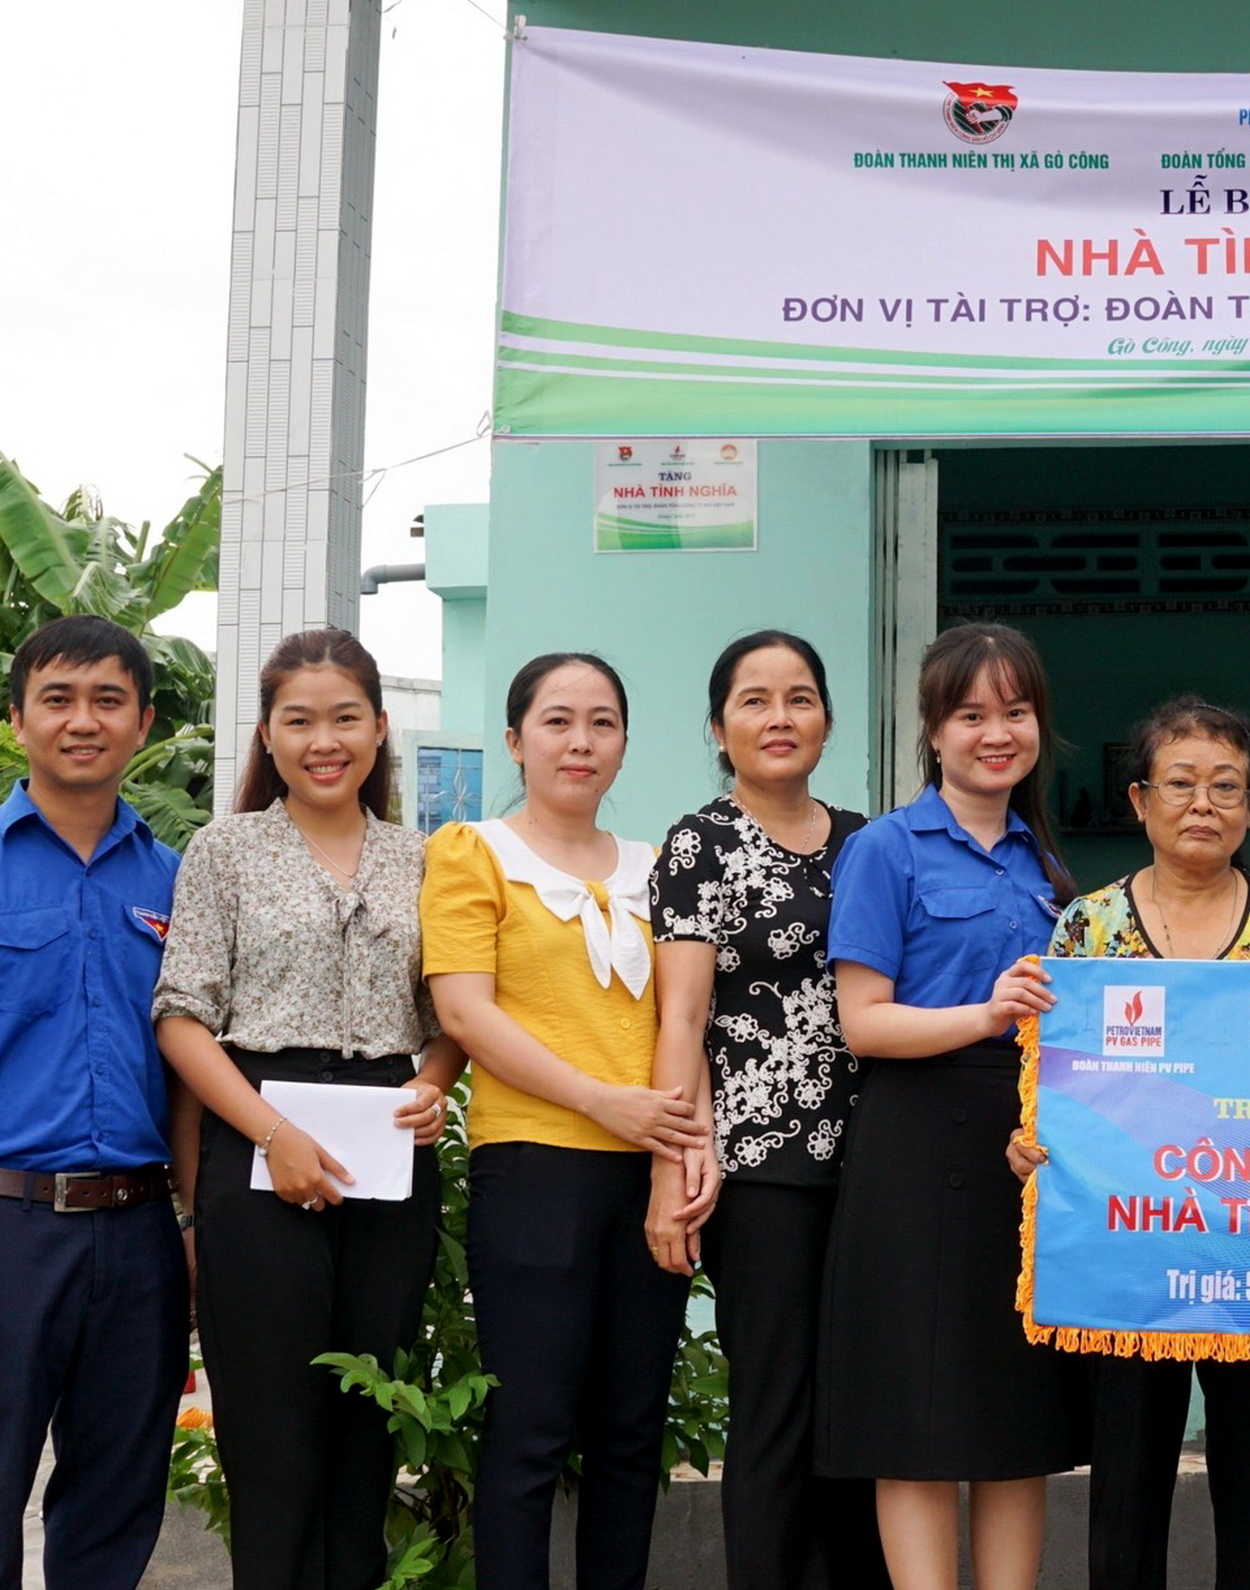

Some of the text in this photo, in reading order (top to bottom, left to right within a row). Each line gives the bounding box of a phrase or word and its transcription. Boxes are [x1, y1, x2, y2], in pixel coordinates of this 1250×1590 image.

[854, 150, 1109, 172] ĐOÀN THANH NIÊN THỊ XÃ GÒ CÔNG
[1161, 151, 1201, 169] ĐOÀN
[1207, 148, 1246, 168] TỔNG
[1160, 175, 1210, 215] LỄ
[1036, 228, 1164, 277] NHÀ
[782, 295, 864, 322] ĐƠN
[879, 298, 913, 328] VỊ
[926, 290, 986, 322] TÀI
[1000, 295, 1090, 328] TRỢ:
[1105, 290, 1213, 321] ĐOÀN
[613, 483, 737, 498] NHÀ TÌNH NGHĨA
[1106, 1025, 1162, 1036] PETROVIETNAM
[1106, 1036, 1162, 1047] PV GAS PIPE
[1107, 1188, 1208, 1233] NHÀ
[1167, 1269, 1196, 1305] Trị
[1200, 1269, 1241, 1304] giá:
